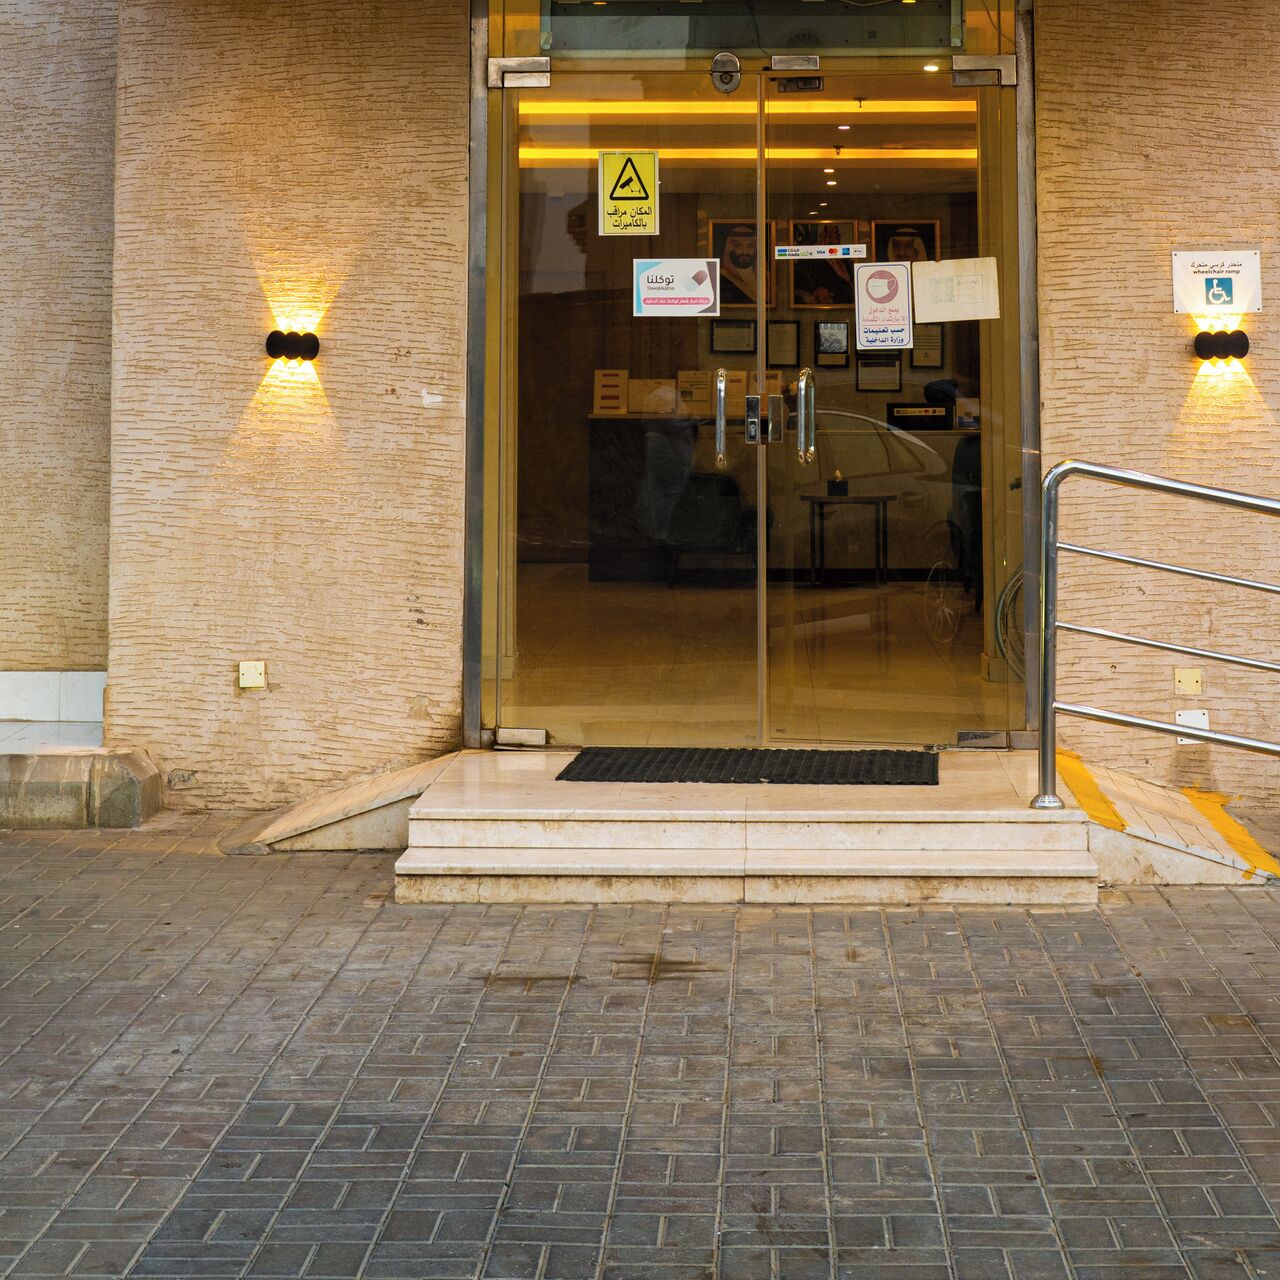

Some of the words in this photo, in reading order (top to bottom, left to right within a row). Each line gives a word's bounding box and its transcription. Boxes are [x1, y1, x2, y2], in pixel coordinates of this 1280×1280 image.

[607, 206, 627, 218] مراقب
[630, 206, 653, 217] المكان
[612, 218, 647, 230] بالكاميرات
[647, 274, 675, 286] توكلنا
